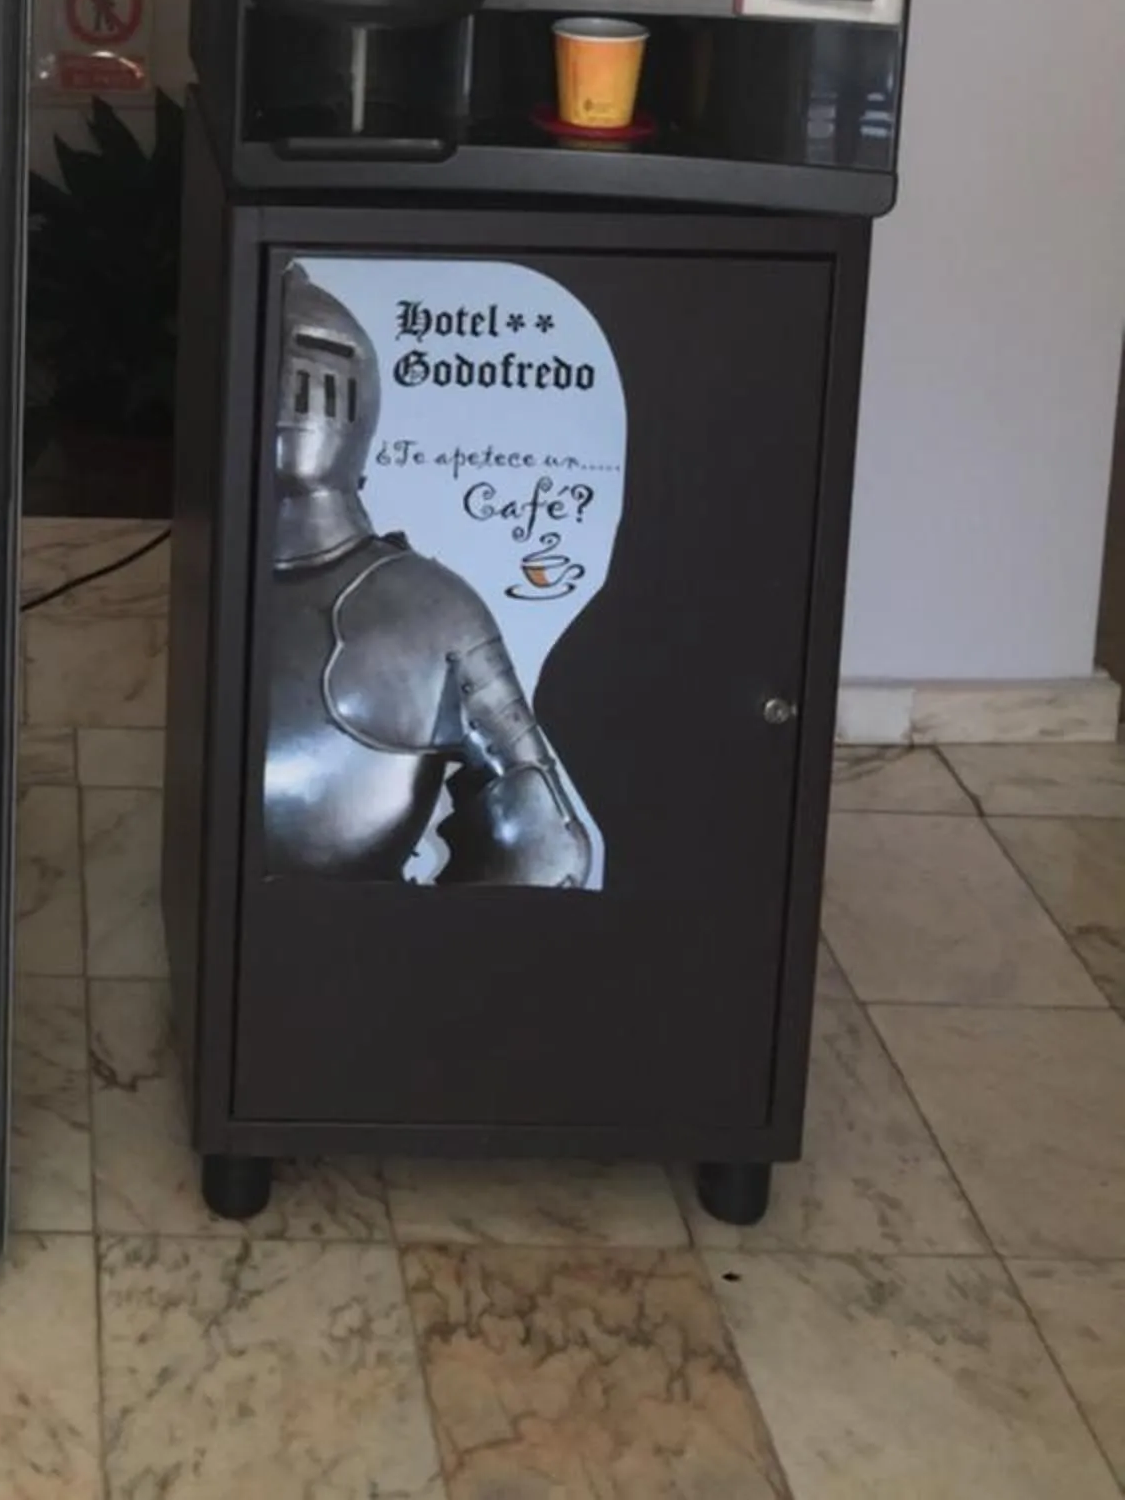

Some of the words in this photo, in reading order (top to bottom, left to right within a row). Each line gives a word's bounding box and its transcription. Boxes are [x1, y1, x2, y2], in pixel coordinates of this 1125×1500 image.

[393, 349, 596, 391] Godofredo
[434, 445, 535, 480] apetece
[463, 475, 595, 543] Café?
